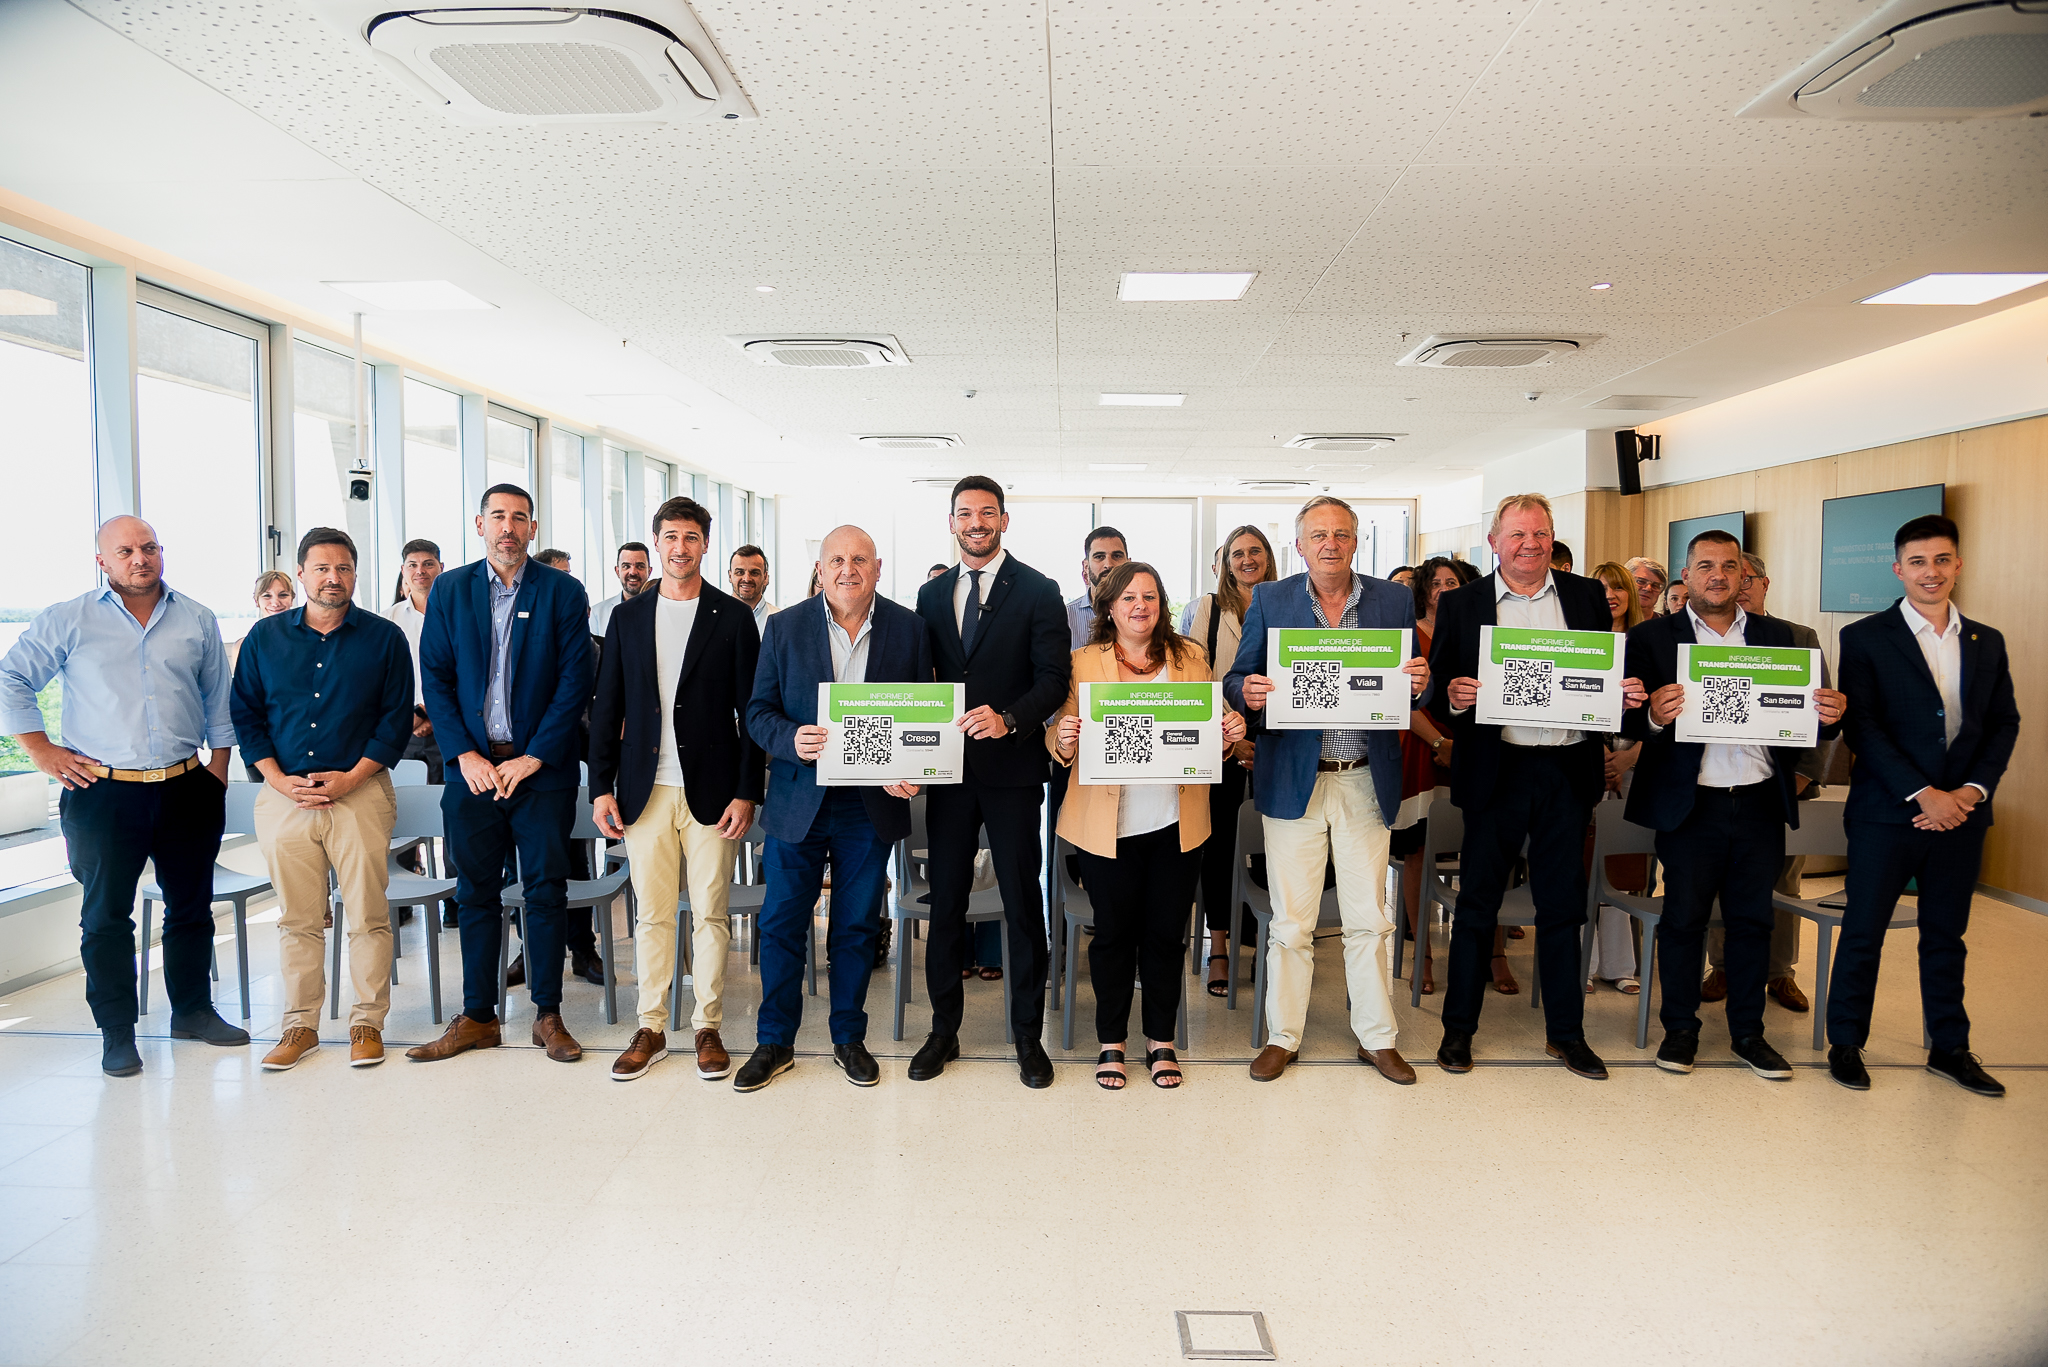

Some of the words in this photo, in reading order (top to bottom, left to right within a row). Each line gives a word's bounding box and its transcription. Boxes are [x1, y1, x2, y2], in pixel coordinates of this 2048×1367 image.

[1867, 543, 1874, 551] DE
[1829, 557, 1847, 565] DIGITAL
[1848, 556, 1876, 564] MUNICIPAL
[1877, 555, 1884, 563] DE
[1849, 593, 1860, 604] ER
[1531, 638, 1564, 646] INFORME
[1287, 645, 1362, 653] TRANSFORMACIÓN
[1500, 643, 1574, 653] TRANSFORMACIÓN
[1575, 647, 1606, 655] DIGITAL
[1698, 661, 1772, 670] TRANSFORMACIÓN
[1356, 679, 1377, 687] Viale
[838, 699, 913, 707] TRANSFORMACIÓN
[1099, 699, 1174, 707] TRANSFORMACIÓN
[1763, 696, 1777, 704] San
[1778, 697, 1802, 705] Benito
[1582, 713, 1595, 721] ER
[906, 734, 937, 743] Crespo
[1166, 735, 1196, 743] Ramírez
[923, 768, 937, 776] ER
[1183, 767, 1196, 775] ER
